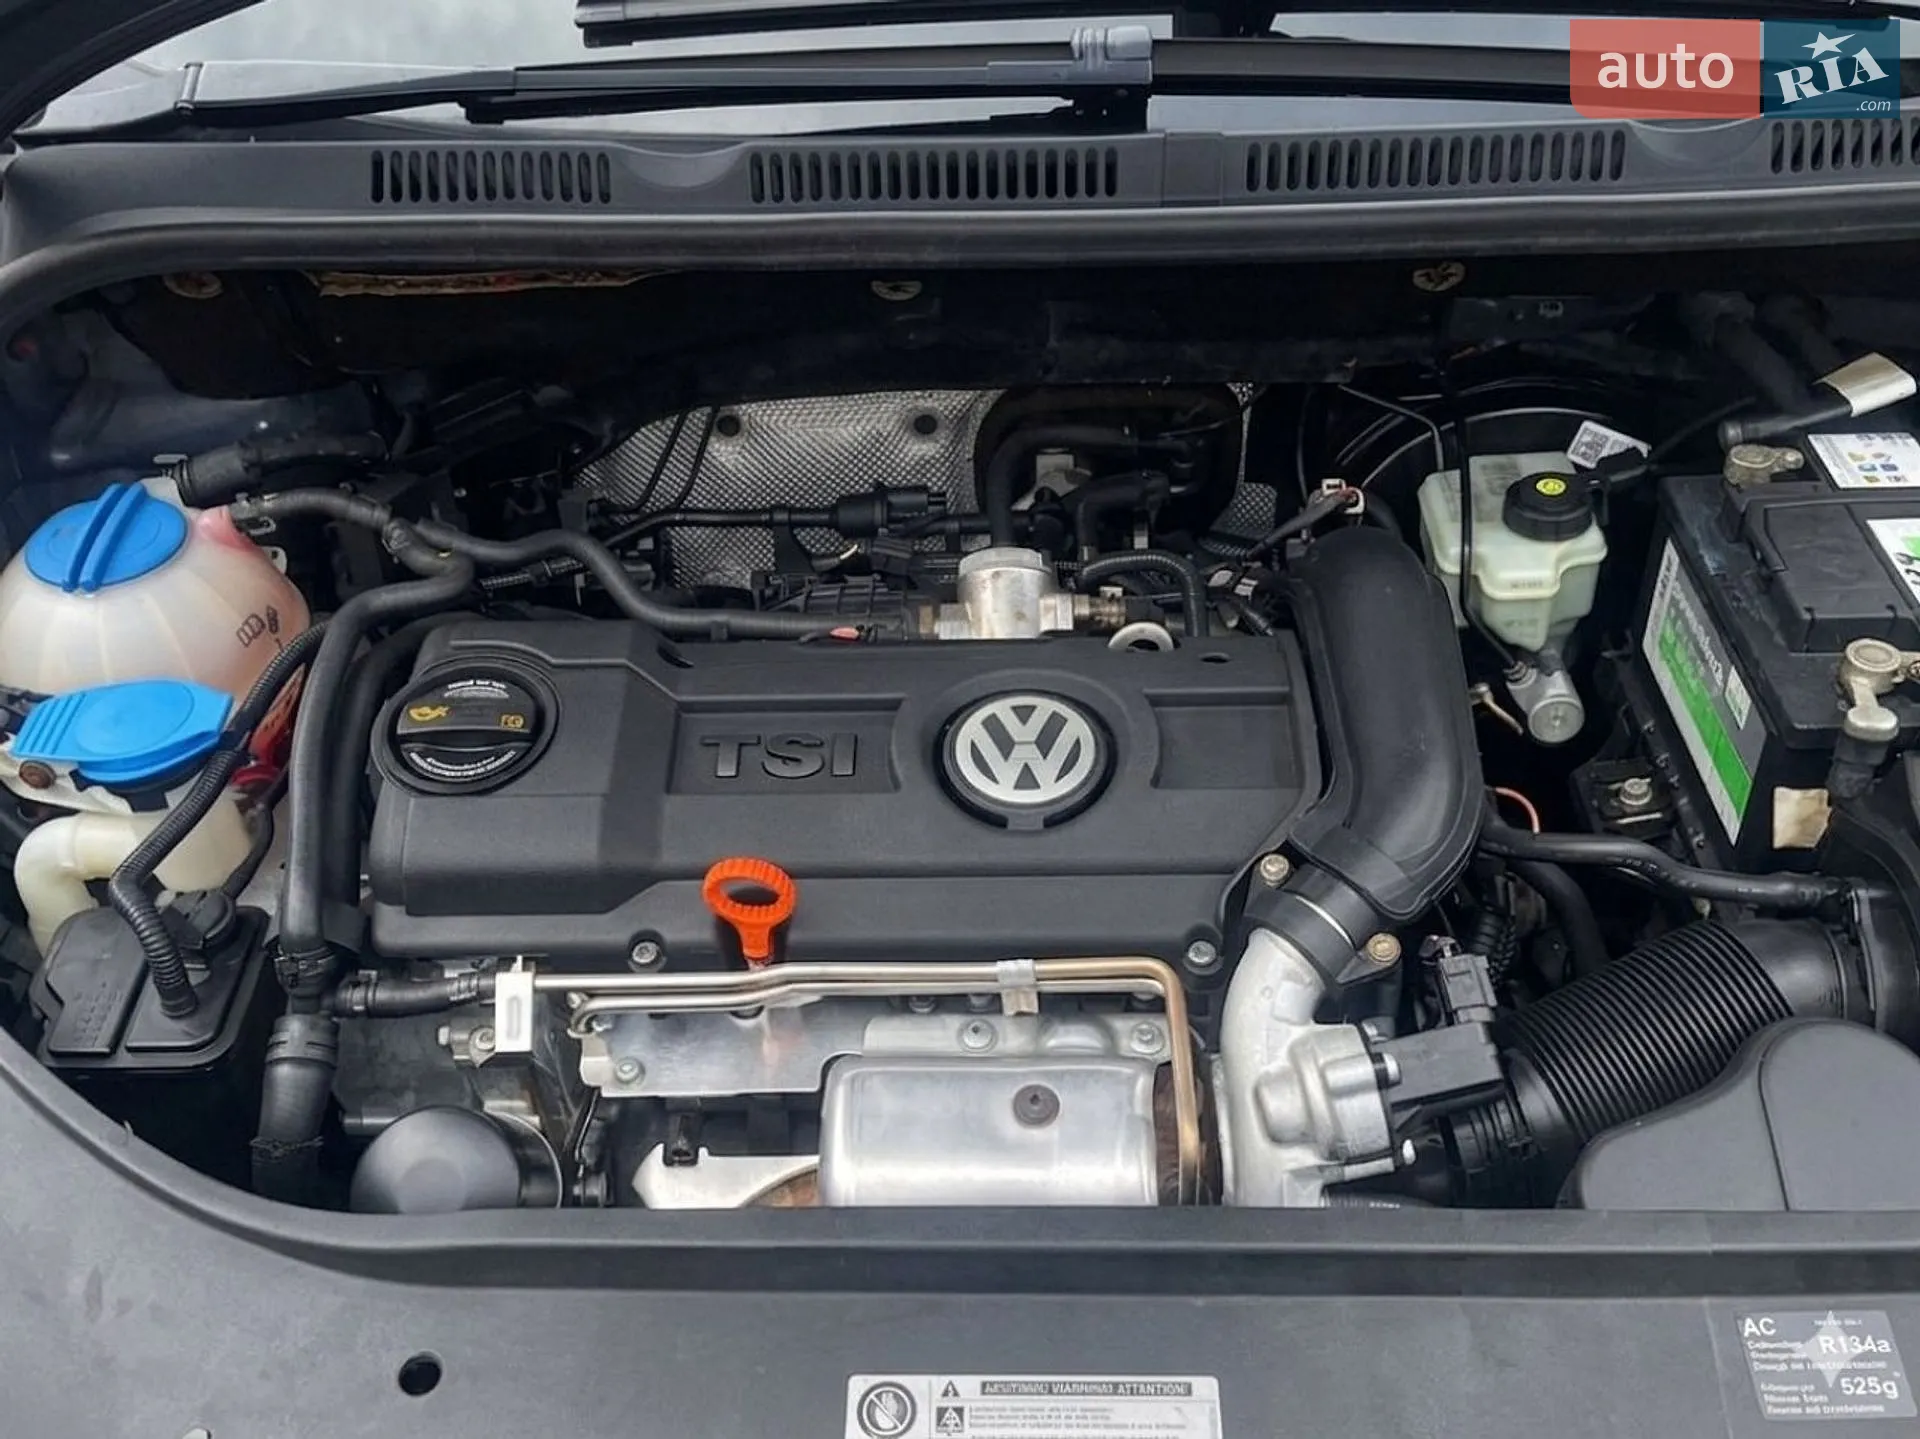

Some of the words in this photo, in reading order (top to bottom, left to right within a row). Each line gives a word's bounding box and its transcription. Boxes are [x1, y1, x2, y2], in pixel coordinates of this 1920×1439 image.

[700, 733, 857, 780] TSI
[1743, 1317, 1776, 1337] AC
[1840, 1376, 1899, 1399] 525g
